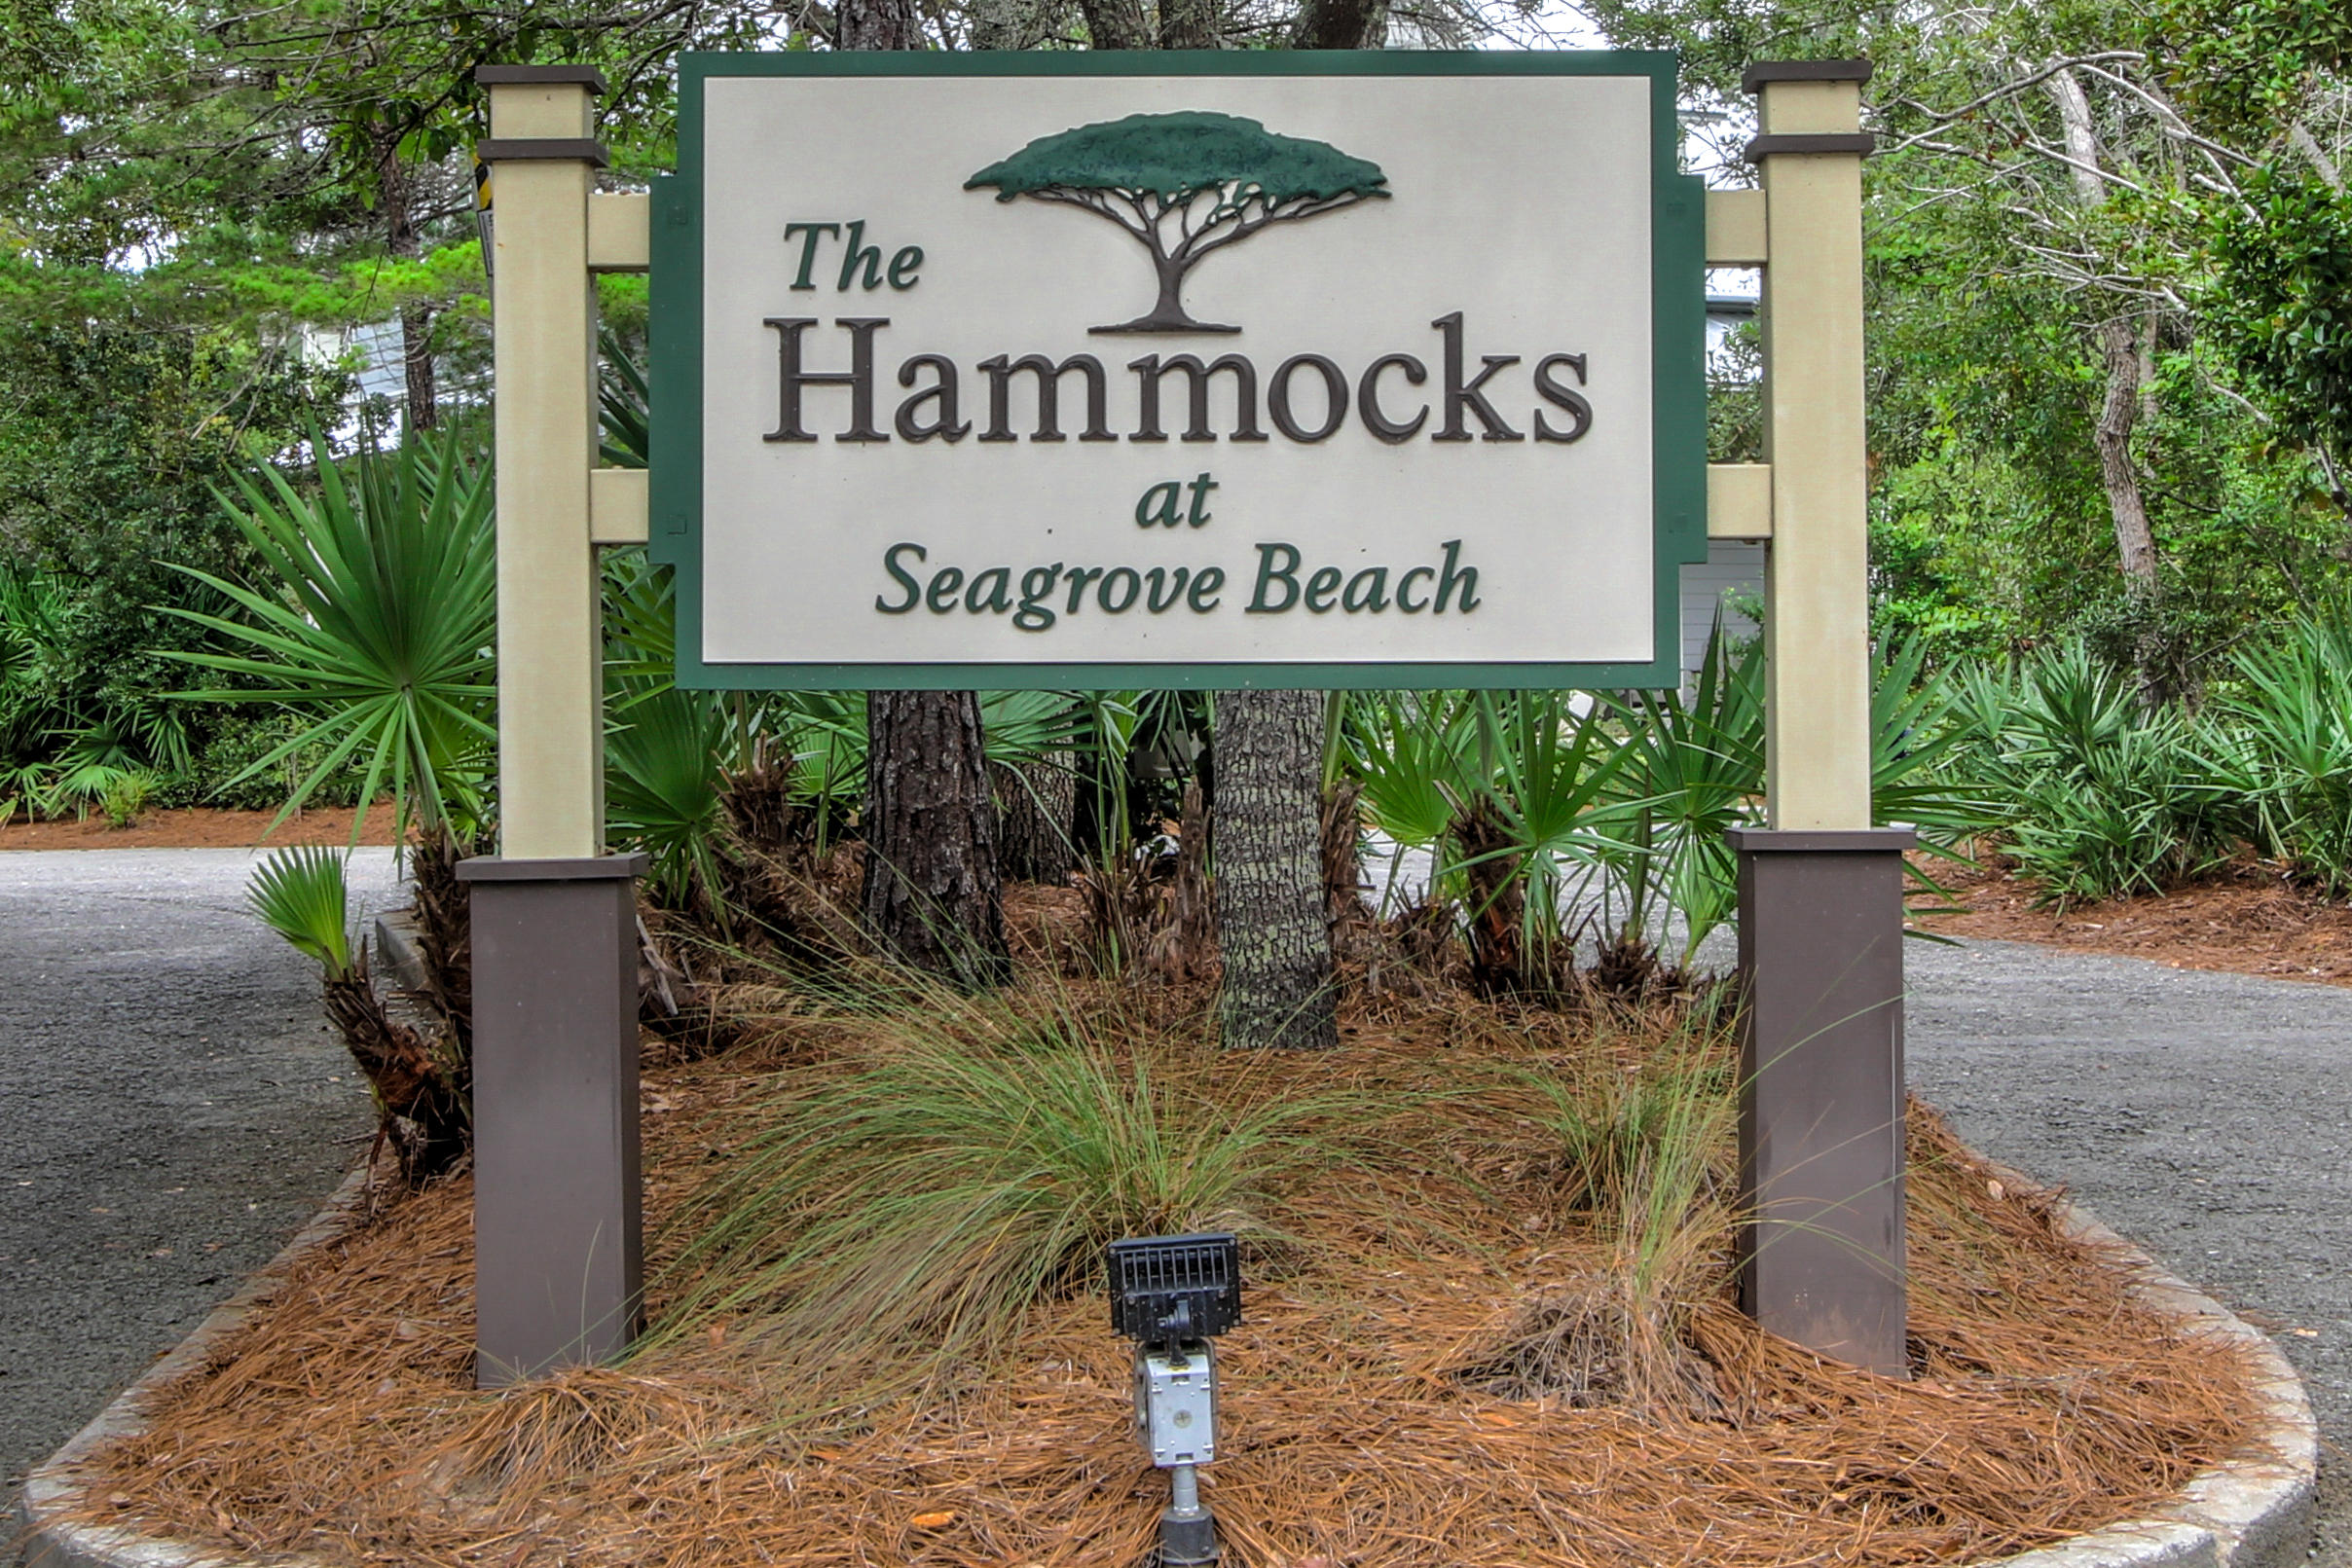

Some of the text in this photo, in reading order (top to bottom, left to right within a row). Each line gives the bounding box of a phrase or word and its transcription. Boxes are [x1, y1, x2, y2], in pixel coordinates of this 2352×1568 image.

[783, 219, 925, 293] The
[762, 310, 1594, 444] Hammocks
[1135, 472, 1219, 529] at
[874, 539, 1482, 633] Seagrove Beach
